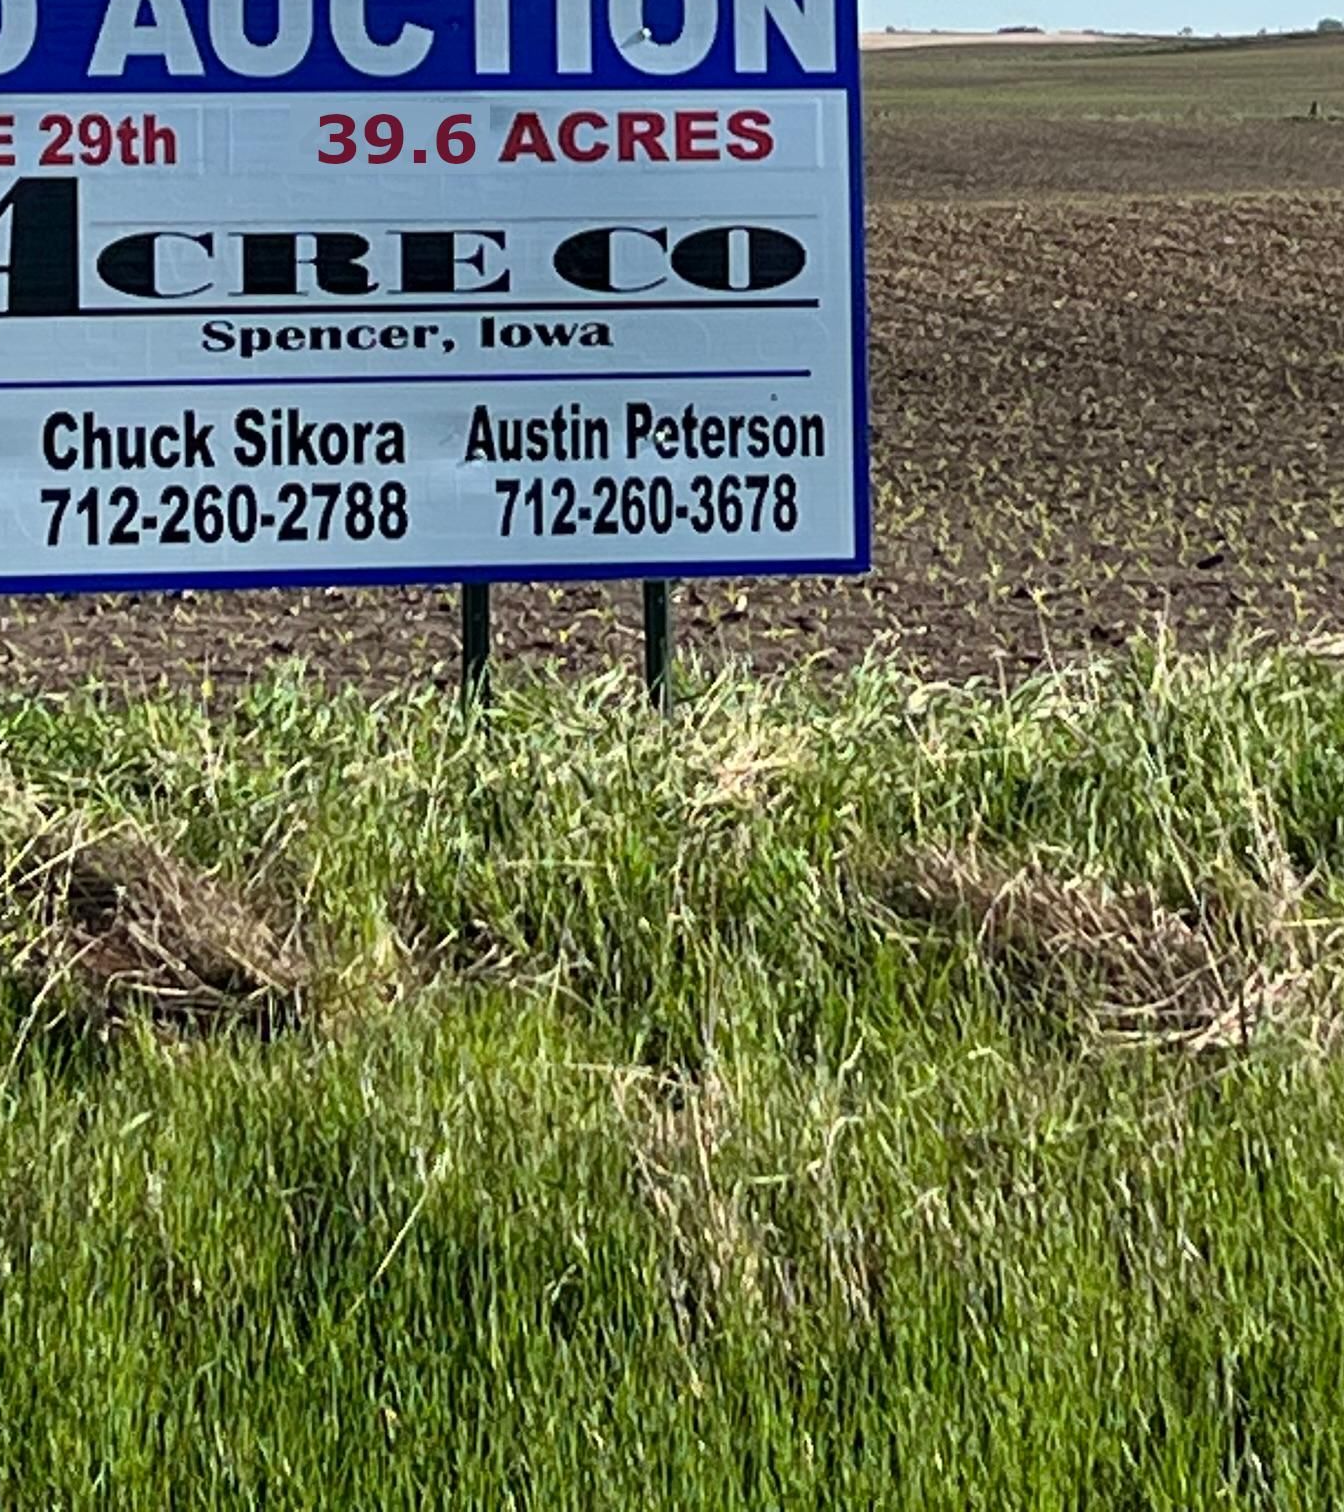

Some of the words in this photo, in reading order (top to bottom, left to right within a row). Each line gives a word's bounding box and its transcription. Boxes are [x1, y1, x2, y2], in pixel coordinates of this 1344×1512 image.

[38, 113, 177, 168] 29th
[317, 112, 477, 165] 39.6
[497, 110, 775, 163] ACRES
[552, 225, 807, 293] CO
[201, 319, 456, 358] Spencer,
[479, 316, 614, 350] Iowa
[42, 409, 214, 471] Chuck
[233, 407, 406, 469] Sikora
[464, 402, 609, 462] Austin
[625, 401, 826, 460] Peterson
[40, 481, 409, 547] 712-260-2788
[494, 473, 798, 537] 712-260-3678
